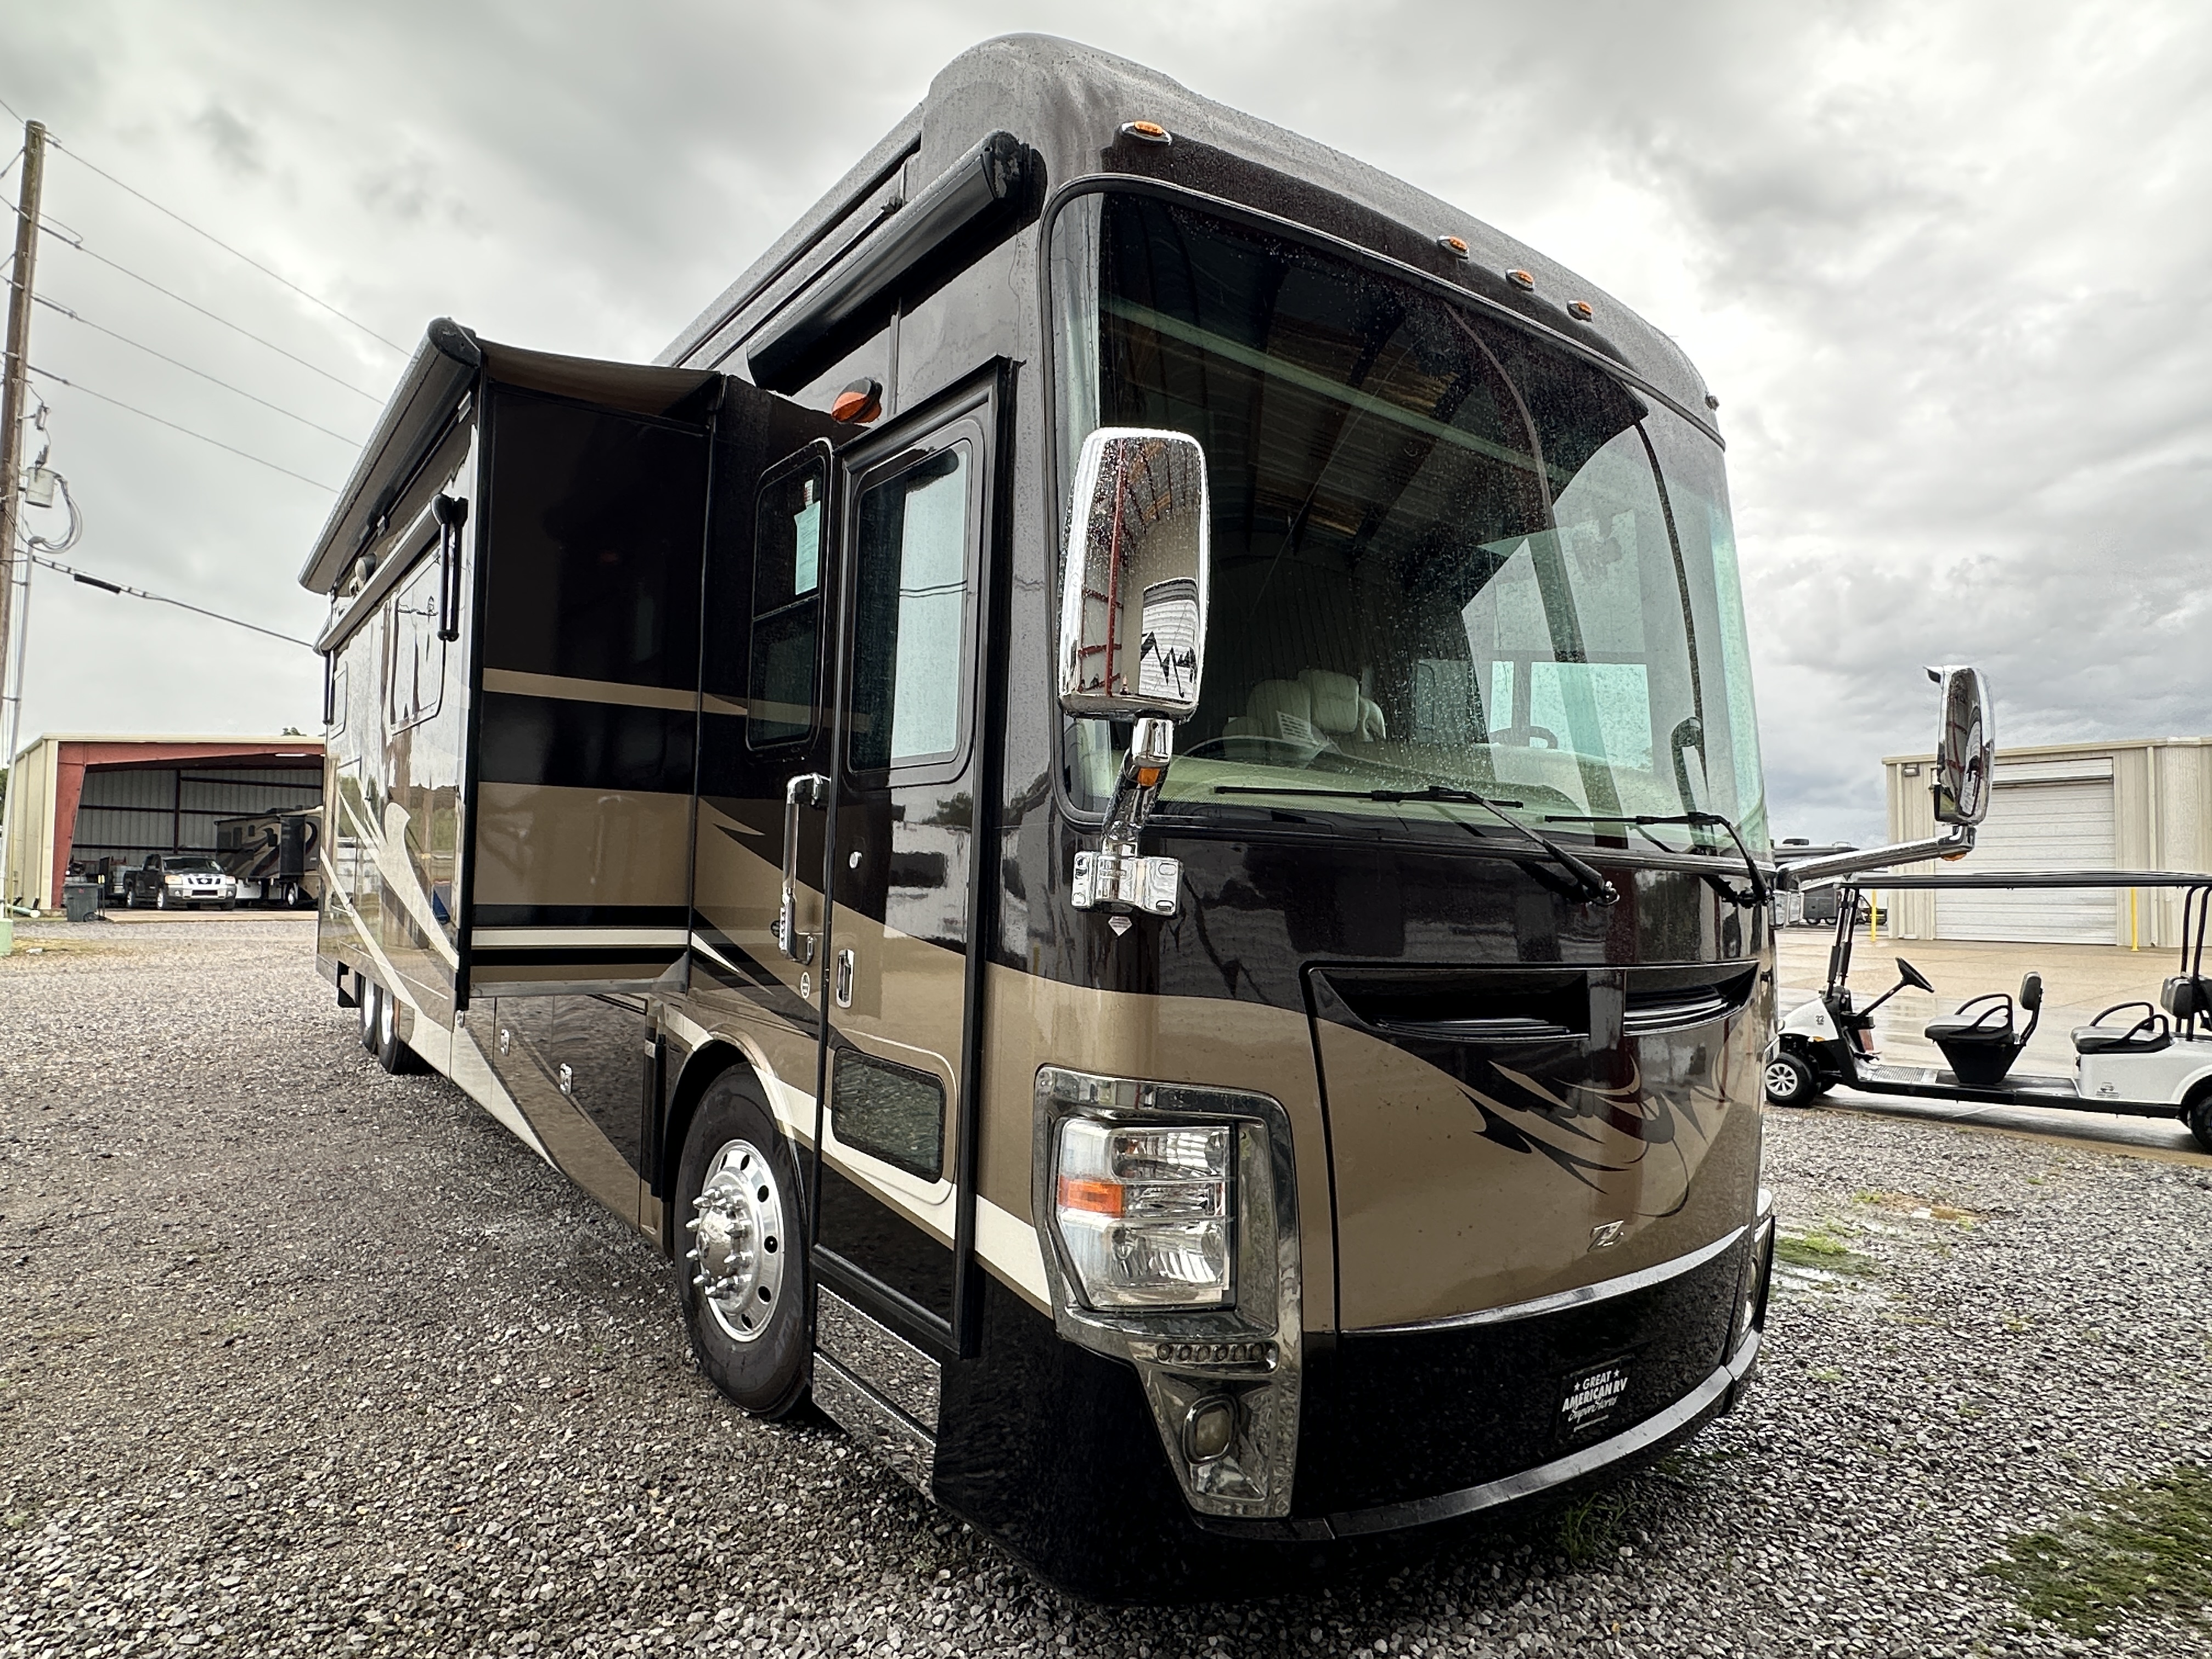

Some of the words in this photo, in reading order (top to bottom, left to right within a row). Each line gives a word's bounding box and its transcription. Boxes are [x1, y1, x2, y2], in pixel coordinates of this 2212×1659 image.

[1583, 1370, 1612, 1390] GREAT
[1562, 1382, 1612, 1412] AMERICAN
[1613, 1377, 1628, 1393] RV
